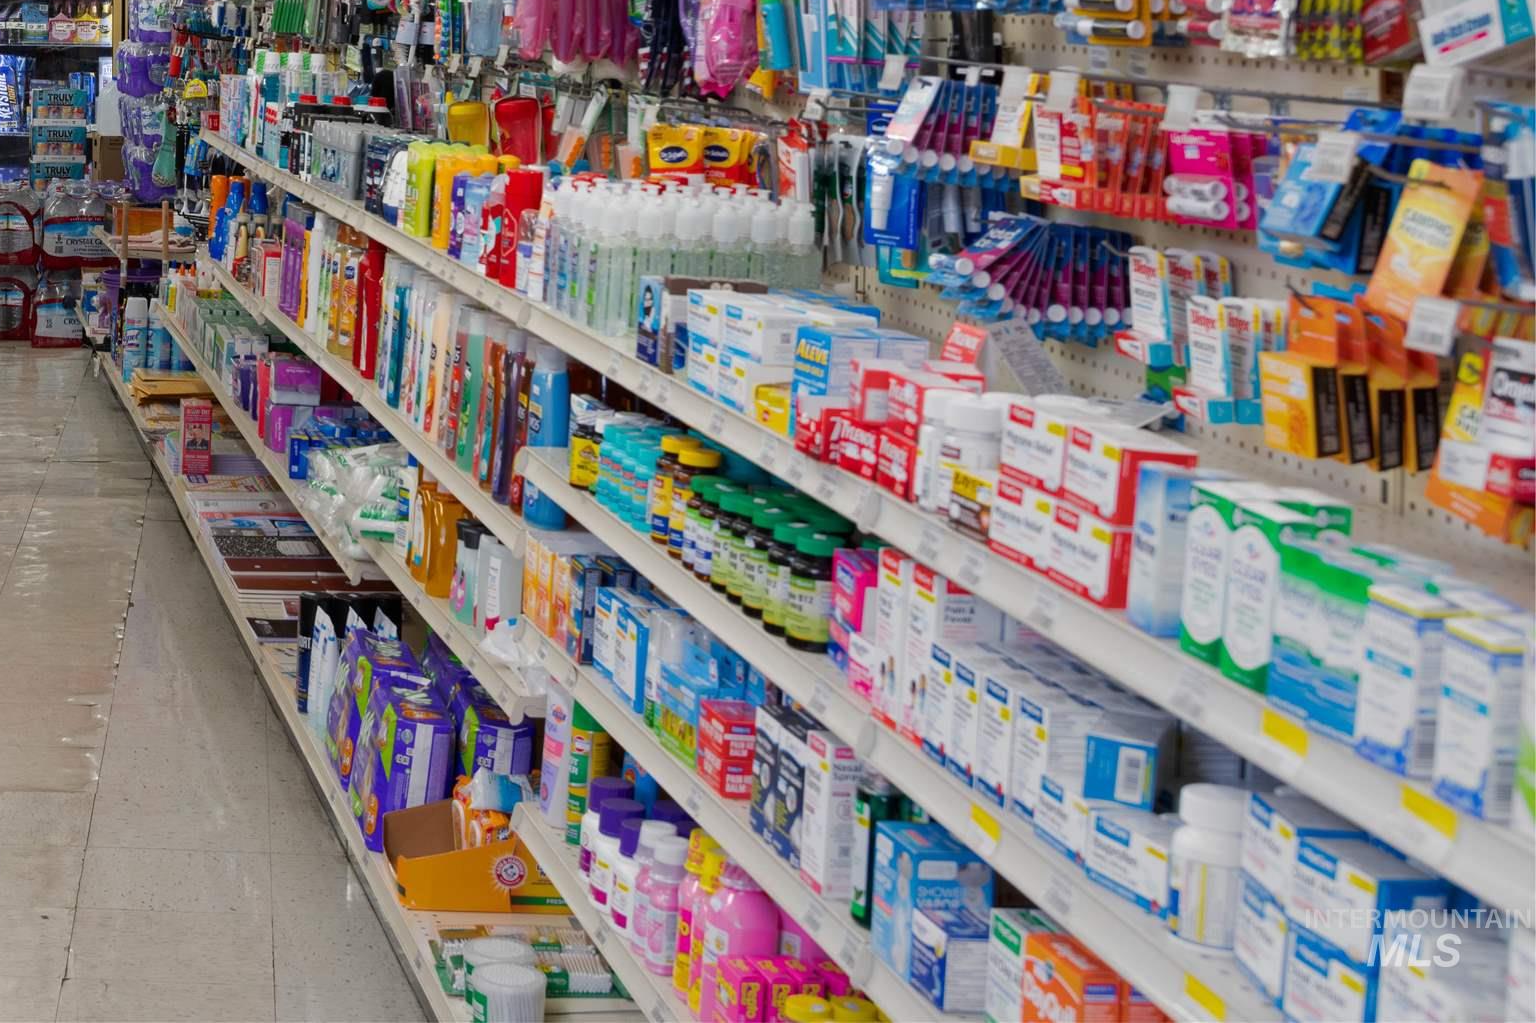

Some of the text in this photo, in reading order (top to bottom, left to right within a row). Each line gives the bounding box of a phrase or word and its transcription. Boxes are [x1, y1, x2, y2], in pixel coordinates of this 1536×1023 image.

[48, 93, 74, 103] TRULY
[47, 129, 73, 138] TRULY
[45, 166, 71, 175] TRULY
[797, 338, 829, 366] ALEVE
